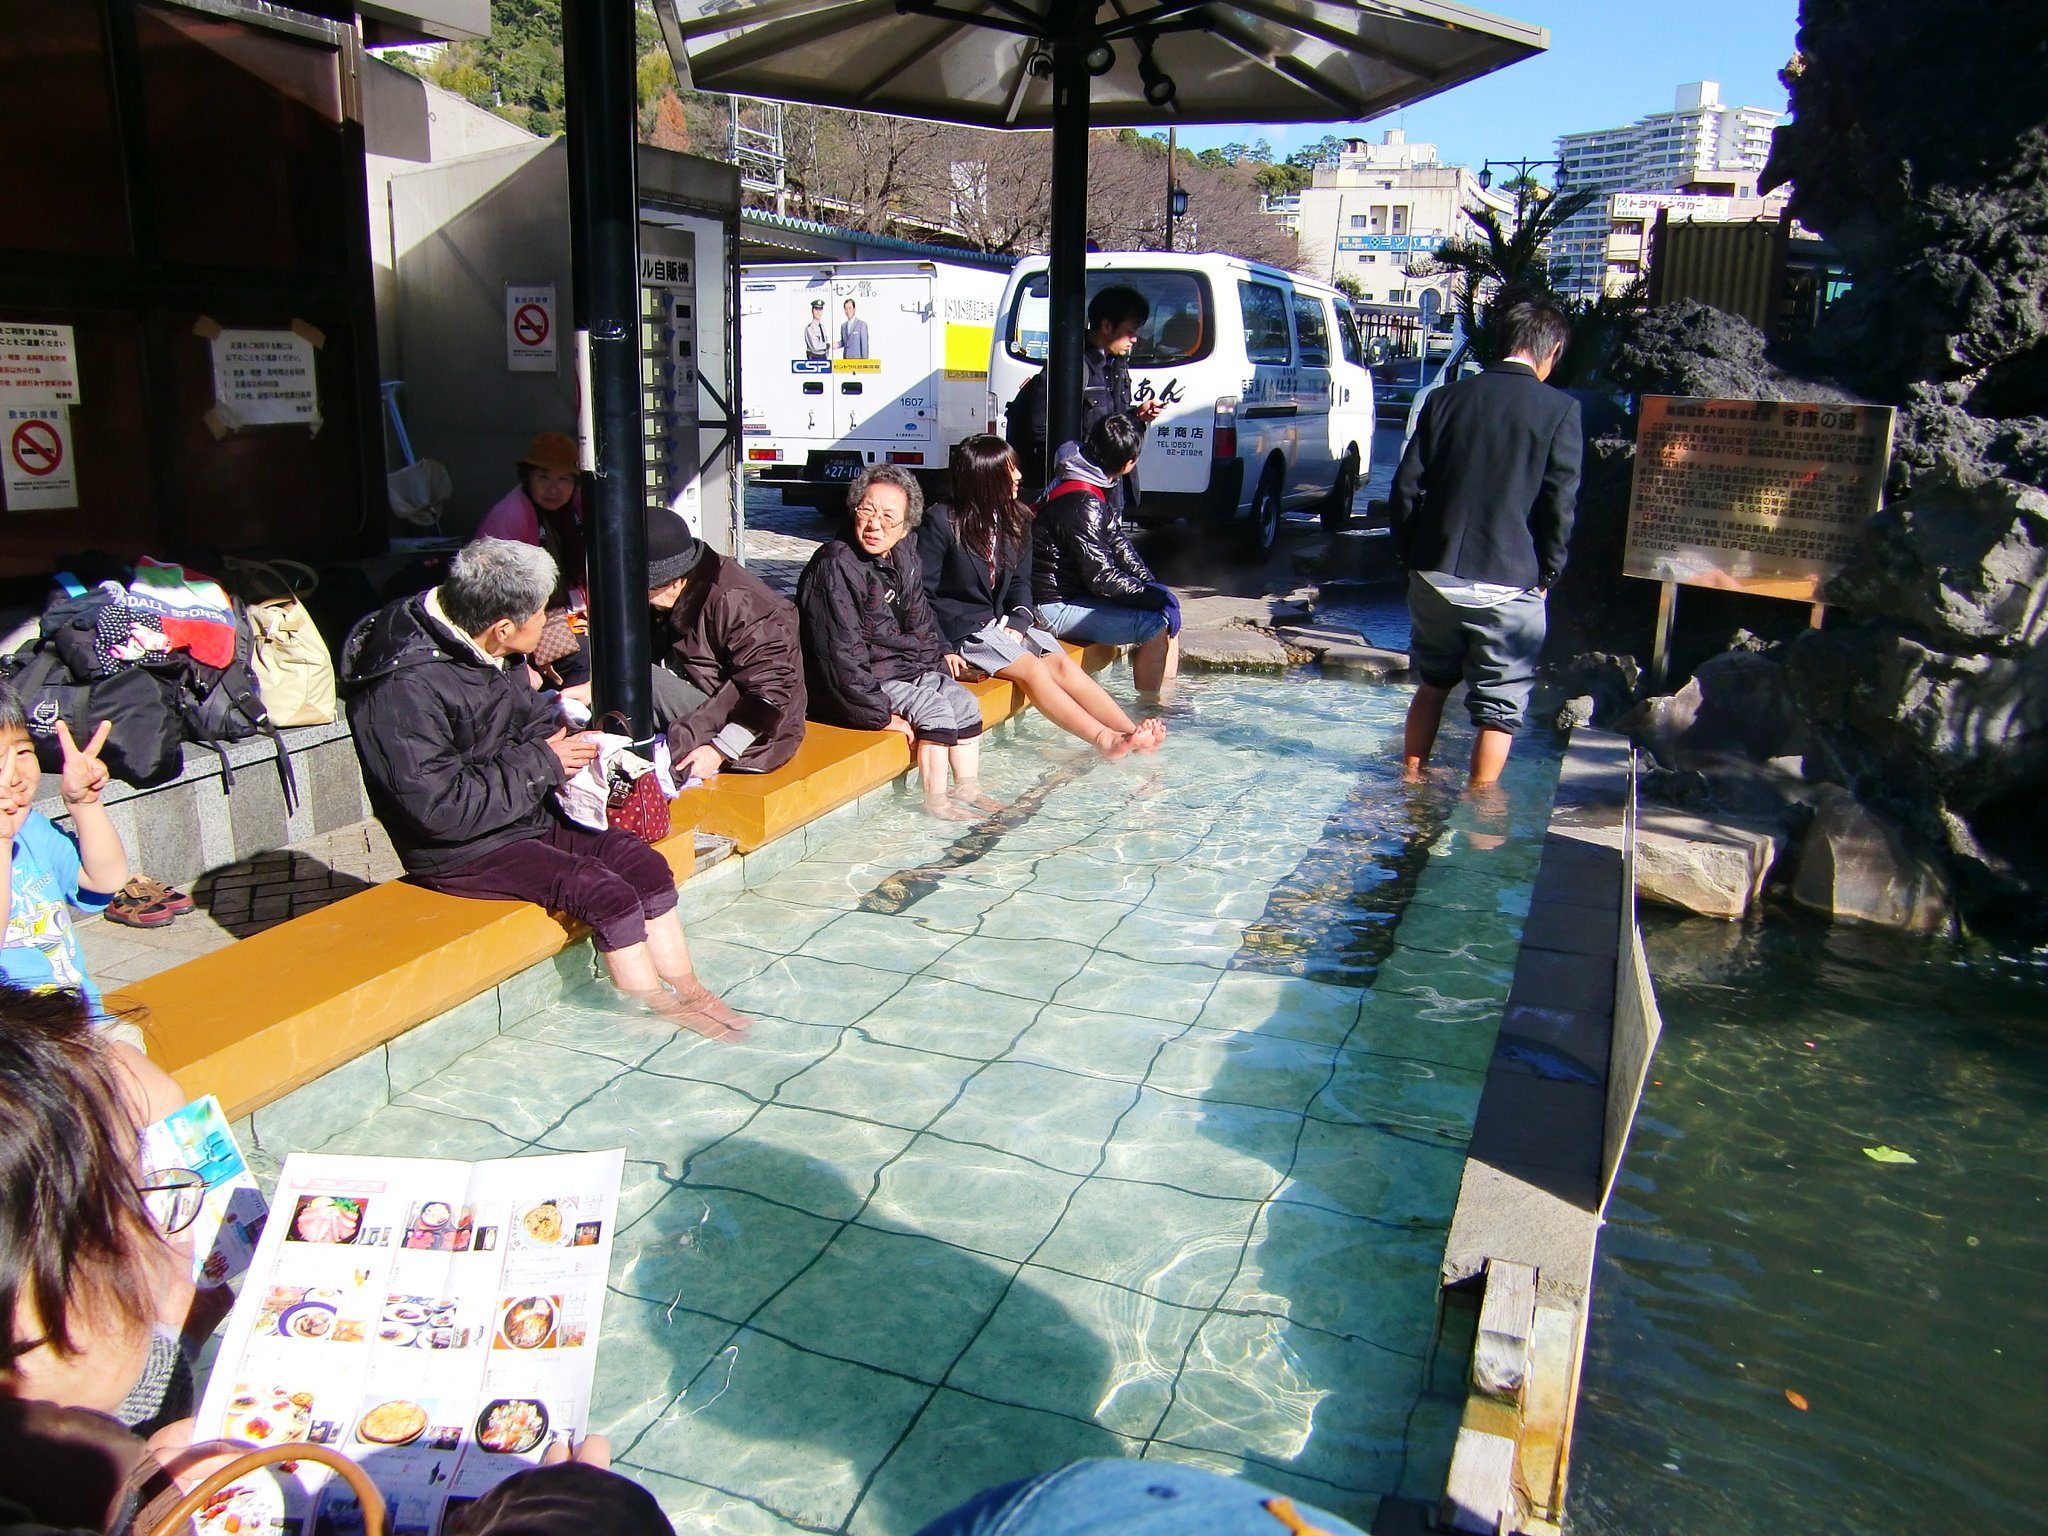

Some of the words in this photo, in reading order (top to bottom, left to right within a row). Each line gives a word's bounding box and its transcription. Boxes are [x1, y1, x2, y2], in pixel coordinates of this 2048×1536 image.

[1629, 199, 1704, 210] トヨタレンタカー
[793, 360, 831, 373] CSP
[900, 397, 924, 407] 1607
[1782, 409, 1857, 430] 家康の湯
[1156, 440, 1170, 448] TEL
